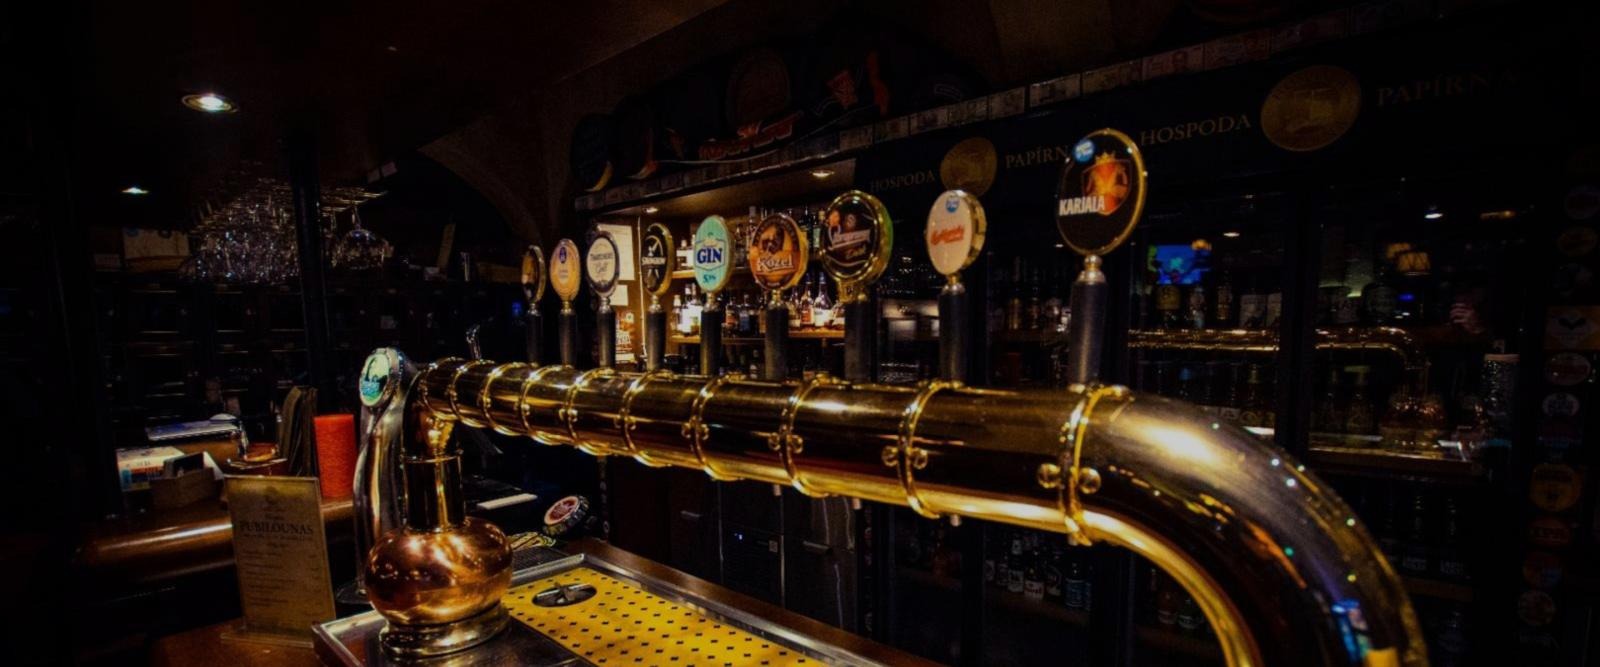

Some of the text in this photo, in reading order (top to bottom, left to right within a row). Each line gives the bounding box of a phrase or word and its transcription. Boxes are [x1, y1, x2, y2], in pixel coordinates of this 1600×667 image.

[1141, 114, 1251, 145] HOSPODA
[869, 169, 936, 193] HOSPODA
[1005, 144, 1070, 169] PAPÍRN
[1059, 196, 1105, 216] KARJALA
[696, 248, 723, 264] GIN
[756, 255, 794, 272] Kozel
